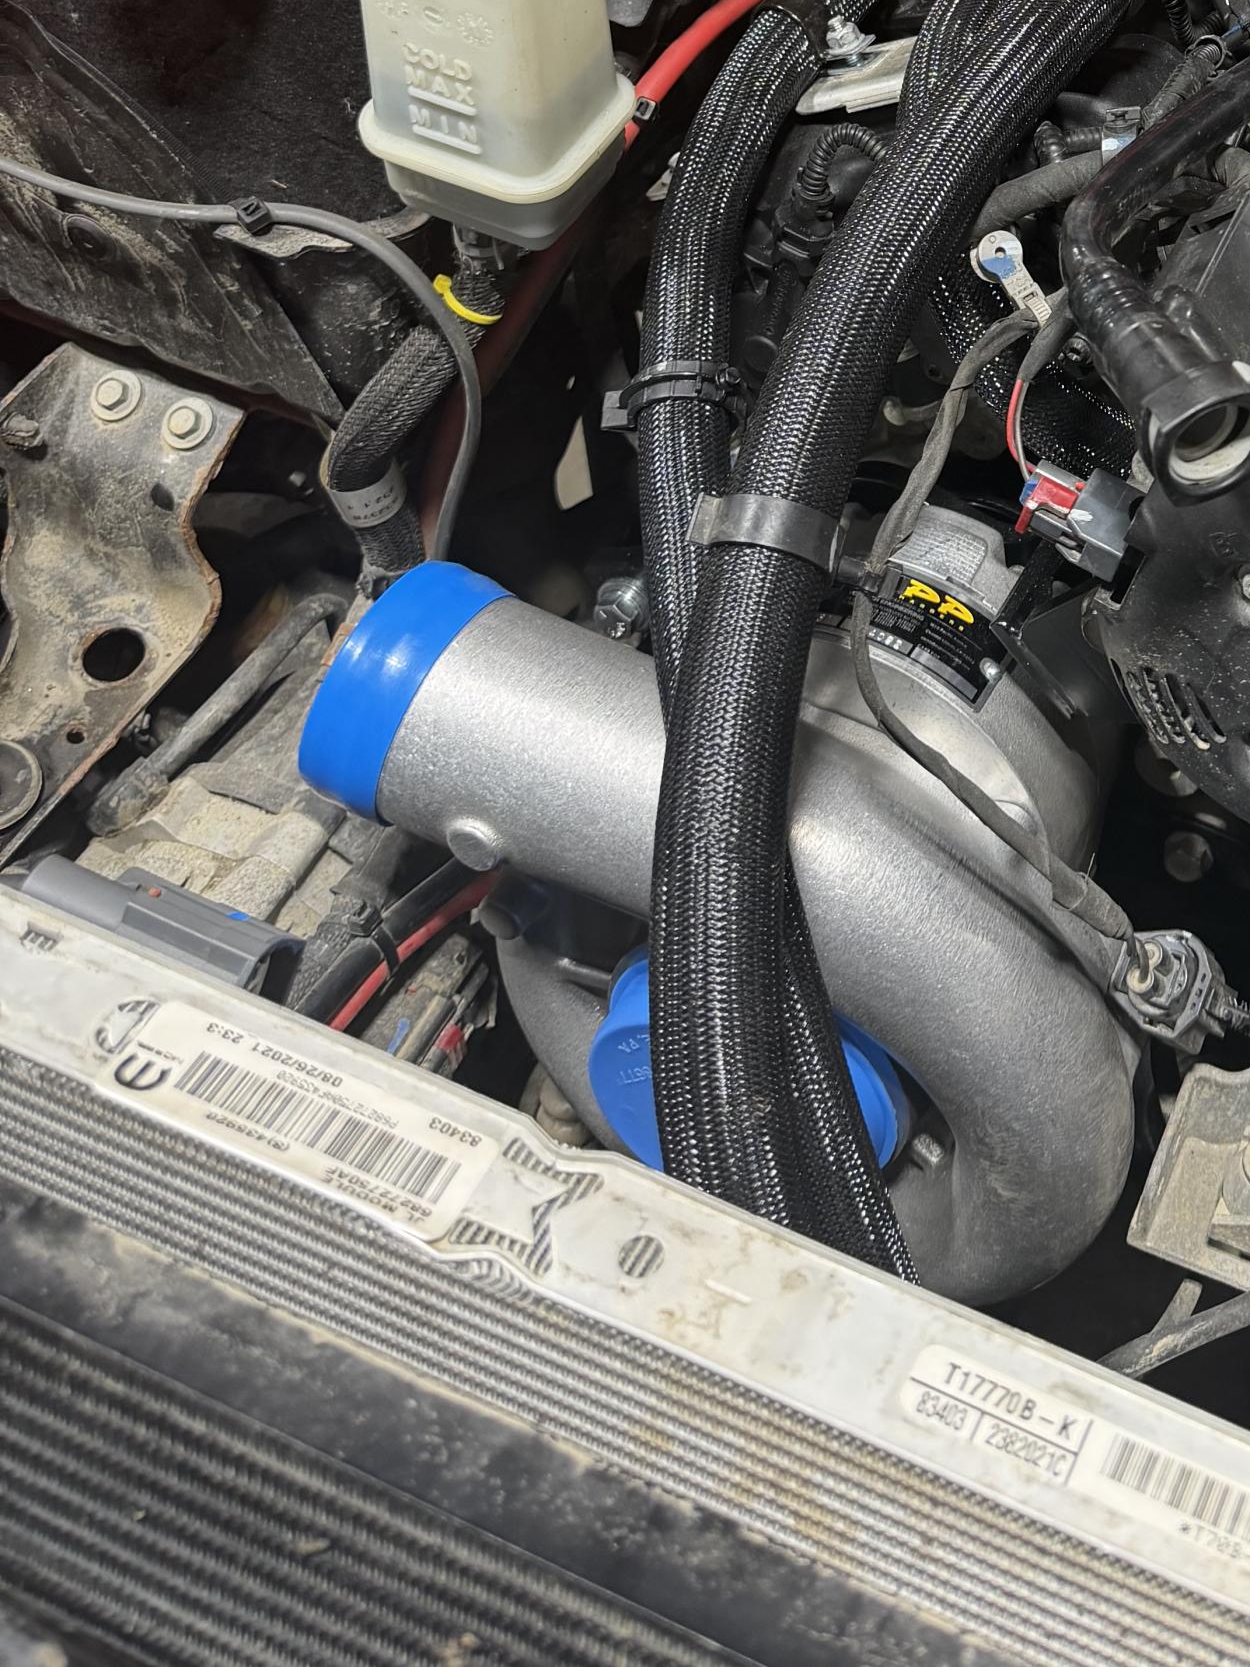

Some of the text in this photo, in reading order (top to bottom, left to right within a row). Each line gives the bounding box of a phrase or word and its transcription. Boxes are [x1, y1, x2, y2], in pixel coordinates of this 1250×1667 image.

[404, 42, 472, 81] COLD
[404, 65, 474, 106] MAX
[408, 105, 478, 143] MIN
[903, 581, 974, 623] PP
[251, 1040, 344, 1088] 08/26/2021
[428, 1116, 481, 1147] 83403
[320, 1172, 397, 1215] MODULE
[915, 1390, 969, 1430] 83403
